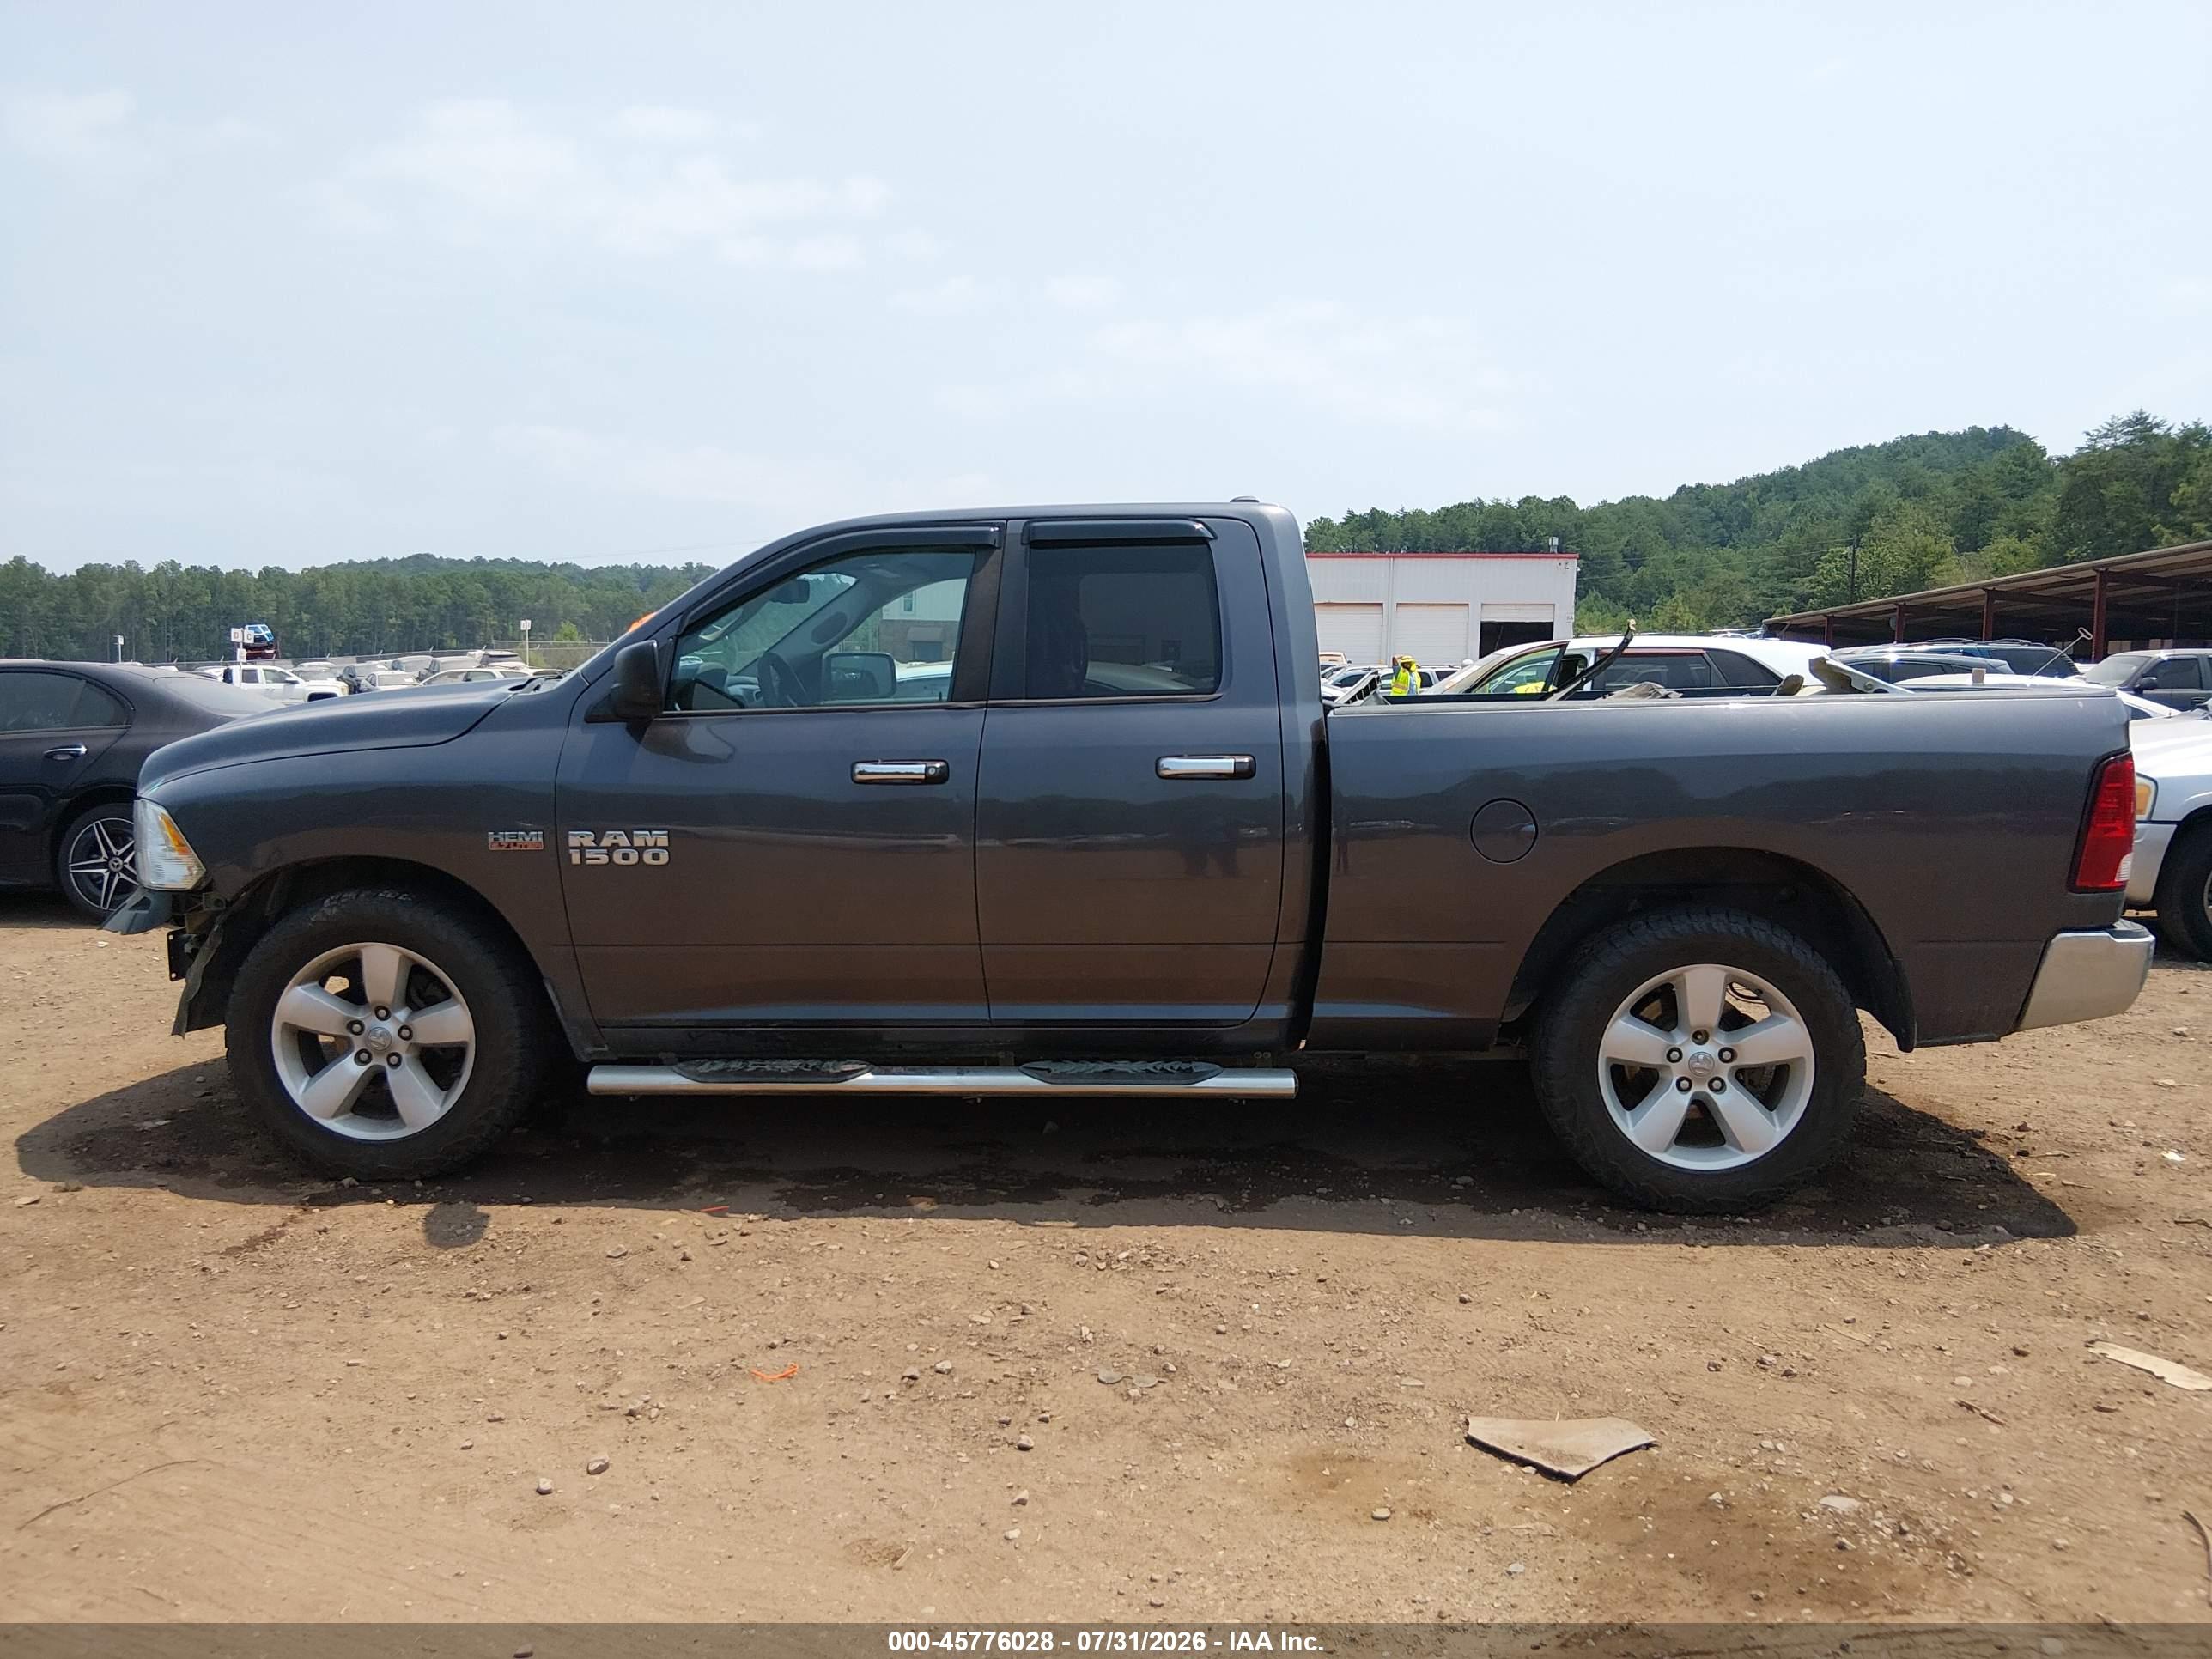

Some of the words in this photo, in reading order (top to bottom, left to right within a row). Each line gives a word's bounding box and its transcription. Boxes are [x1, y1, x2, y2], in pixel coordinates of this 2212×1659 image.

[488, 831, 544, 842] HEMI
[568, 830, 669, 848] RAM
[568, 848, 670, 866] 1500
